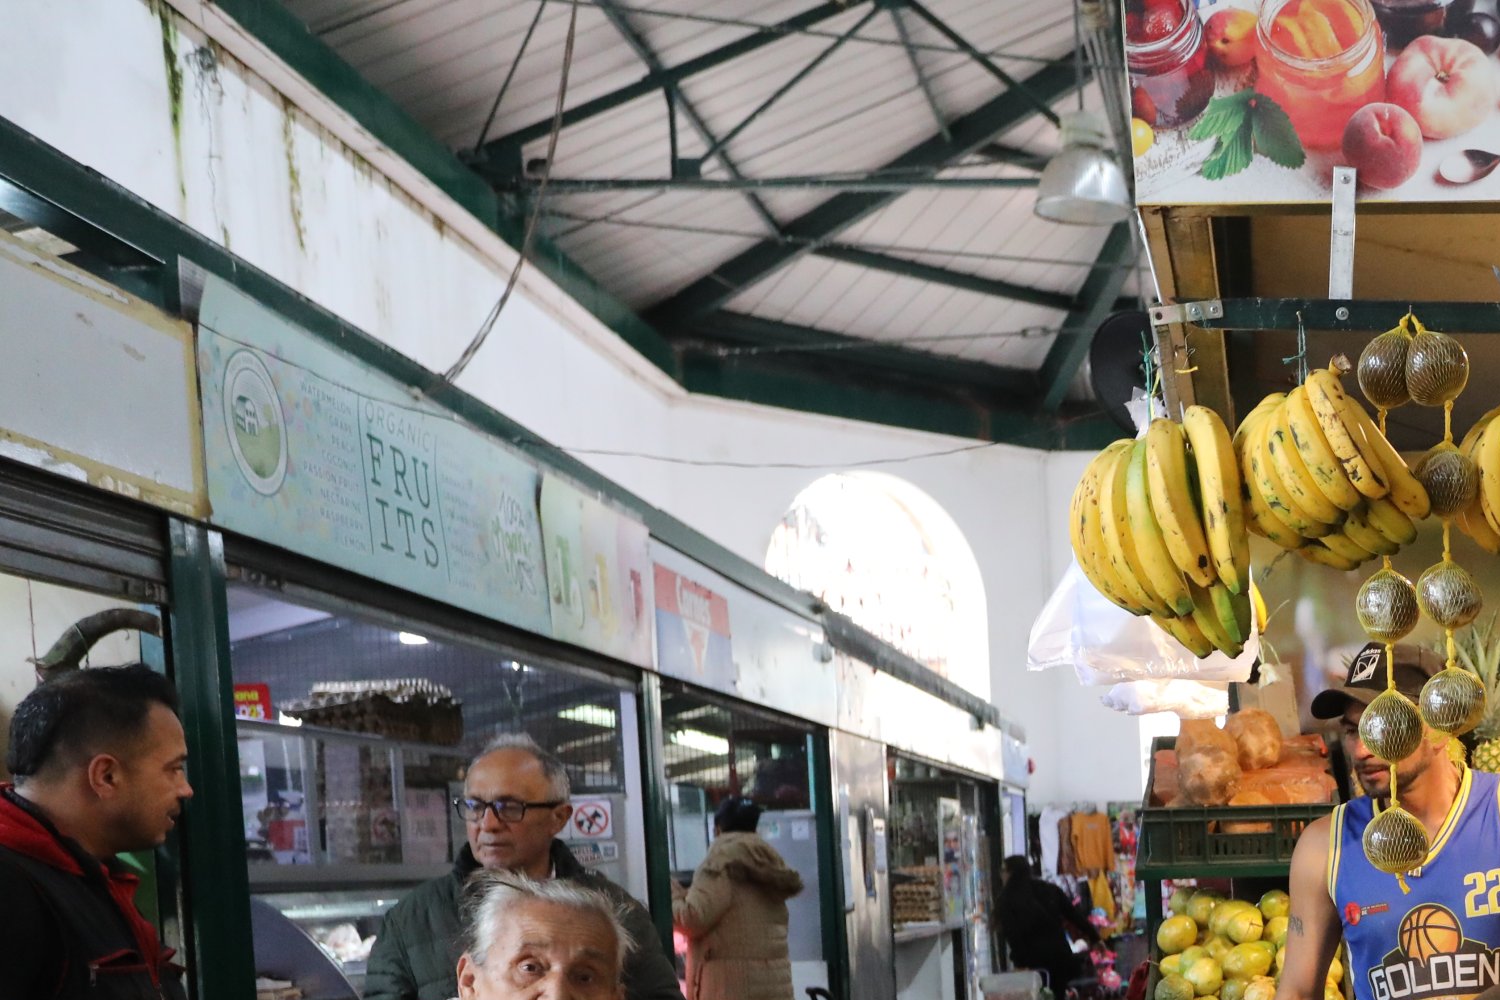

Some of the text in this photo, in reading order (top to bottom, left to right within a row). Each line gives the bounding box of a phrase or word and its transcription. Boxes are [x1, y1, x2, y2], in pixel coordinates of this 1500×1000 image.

[301, 381, 353, 415] WATERMELON
[365, 402, 430, 453] ORGANIC
[366, 432, 431, 509] FRU
[375, 497, 439, 568] ITS
